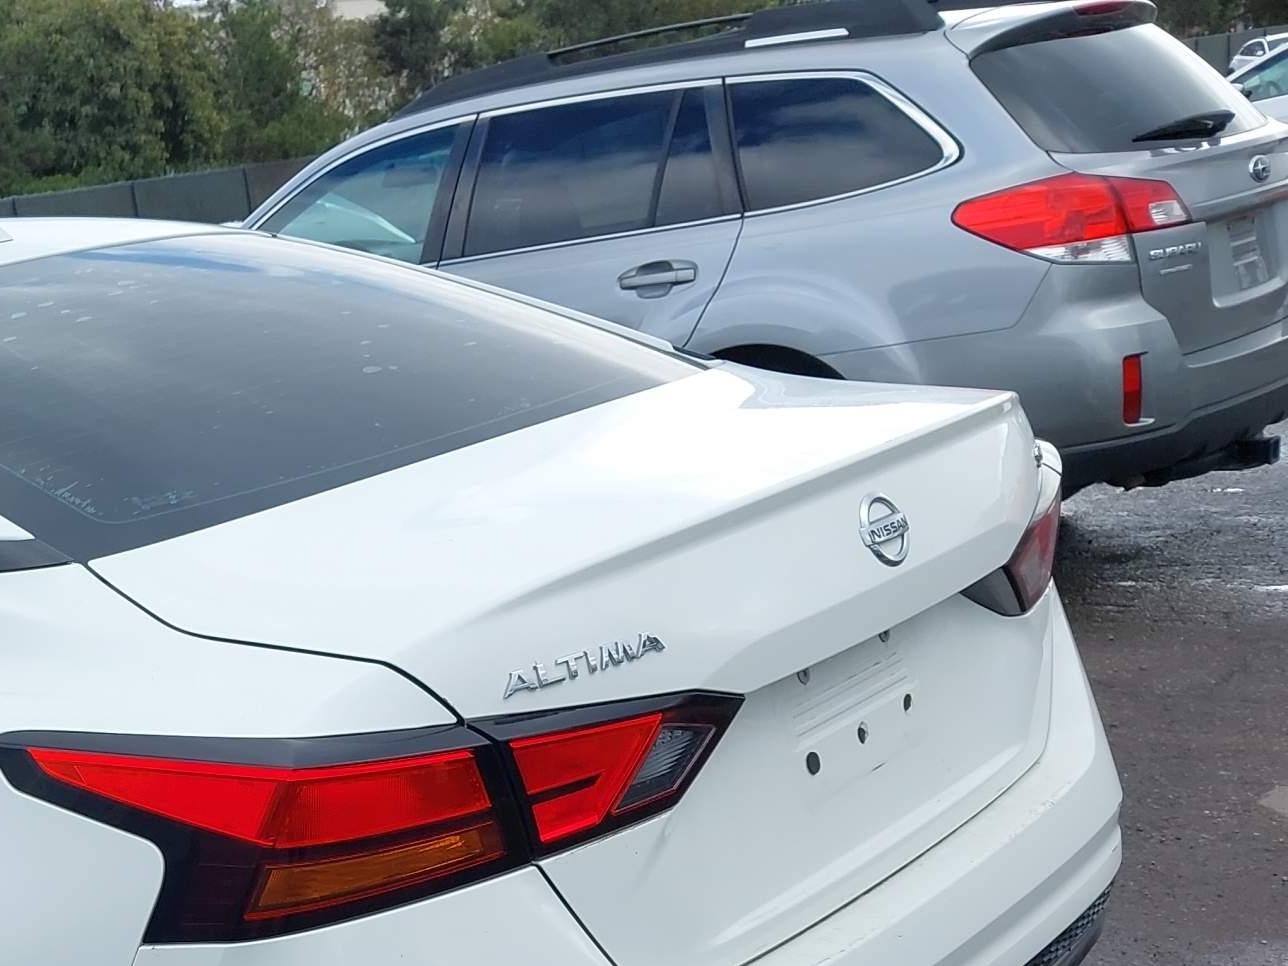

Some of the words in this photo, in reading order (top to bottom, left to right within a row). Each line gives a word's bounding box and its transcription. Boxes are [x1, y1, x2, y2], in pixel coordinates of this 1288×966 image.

[1149, 241, 1202, 260] SUBARU
[870, 517, 908, 541] NISSAN
[503, 632, 667, 700] ALTIMA
